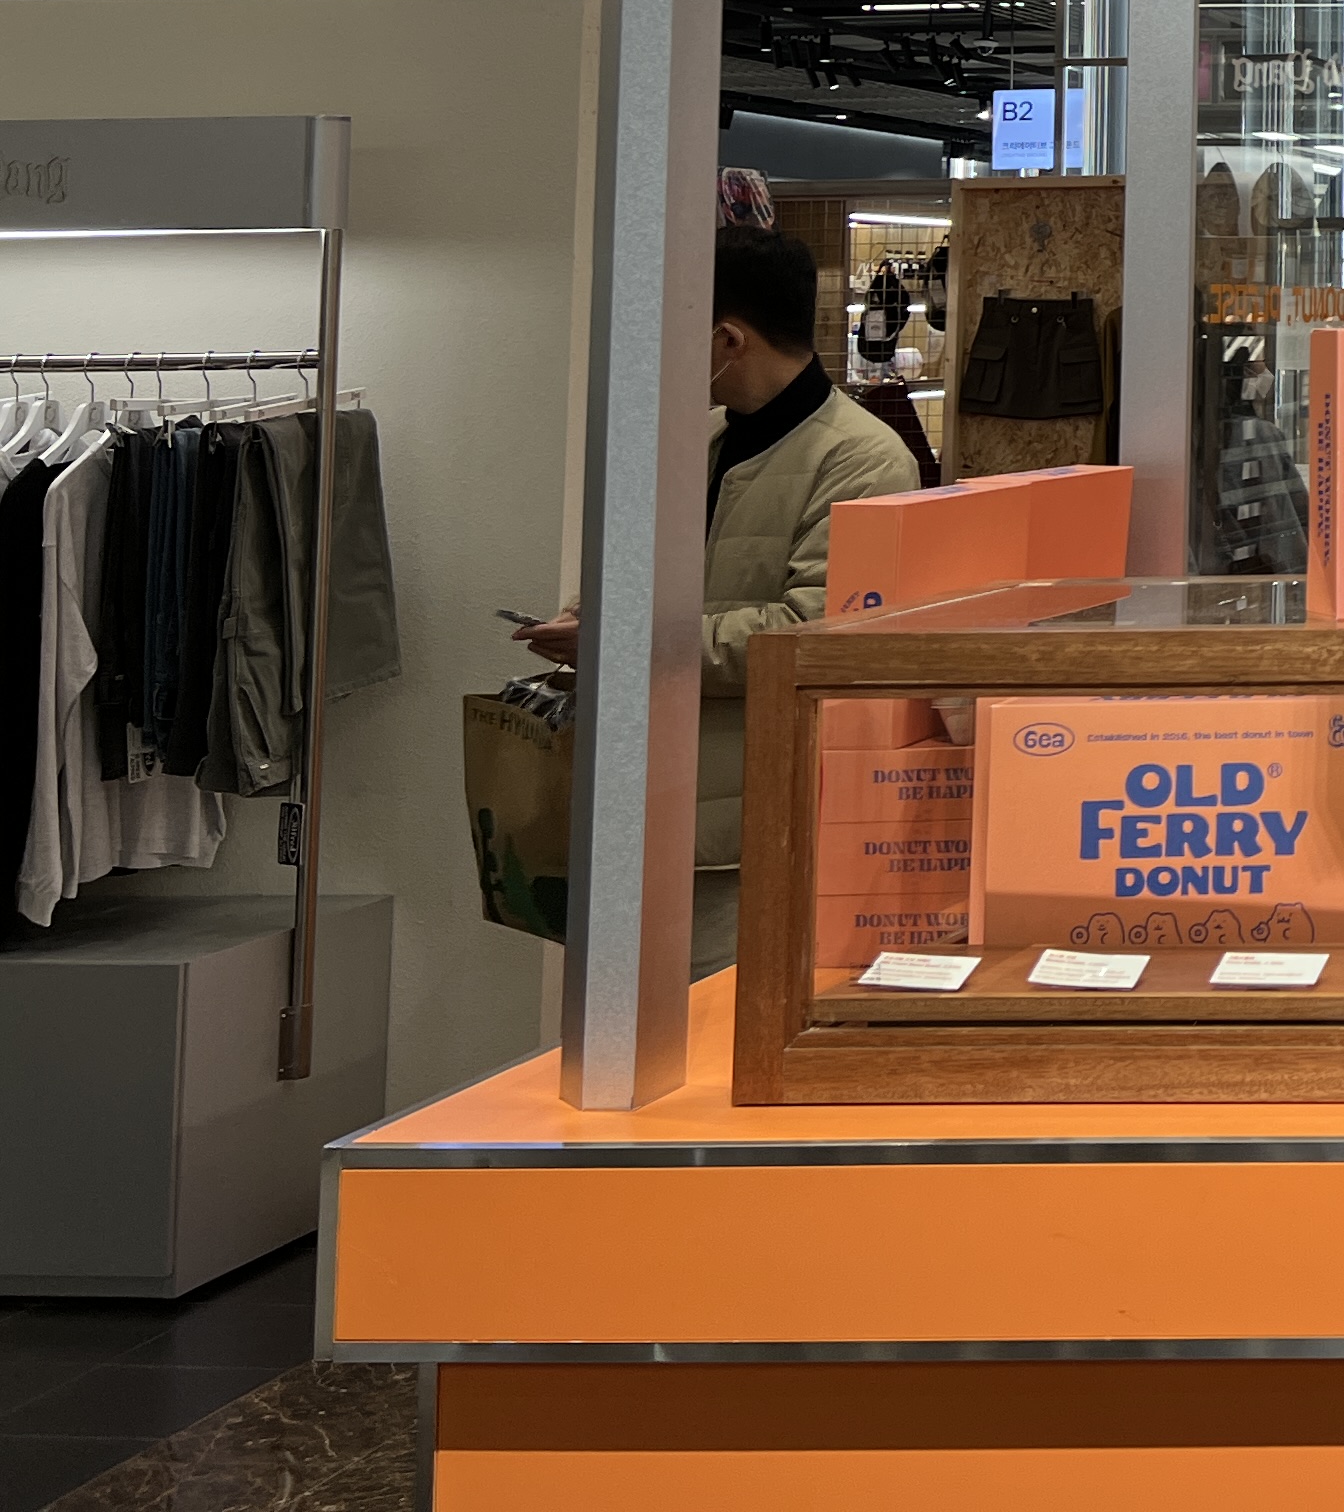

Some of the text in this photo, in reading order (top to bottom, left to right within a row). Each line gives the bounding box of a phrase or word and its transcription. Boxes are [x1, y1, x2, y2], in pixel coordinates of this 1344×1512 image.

[1002, 101, 1033, 121] B2
[1024, 730, 1066, 749] 6ea
[872, 766, 973, 784] DONUT WO
[897, 785, 924, 801] BE
[1125, 762, 1266, 808] OLD
[1079, 799, 1309, 860] FERRY
[864, 839, 971, 855] DONUT WO
[888, 857, 971, 873] BE HAPP
[1115, 864, 1272, 897] DONUT
[854, 913, 922, 928] DONUT
[879, 931, 905, 946] BE
